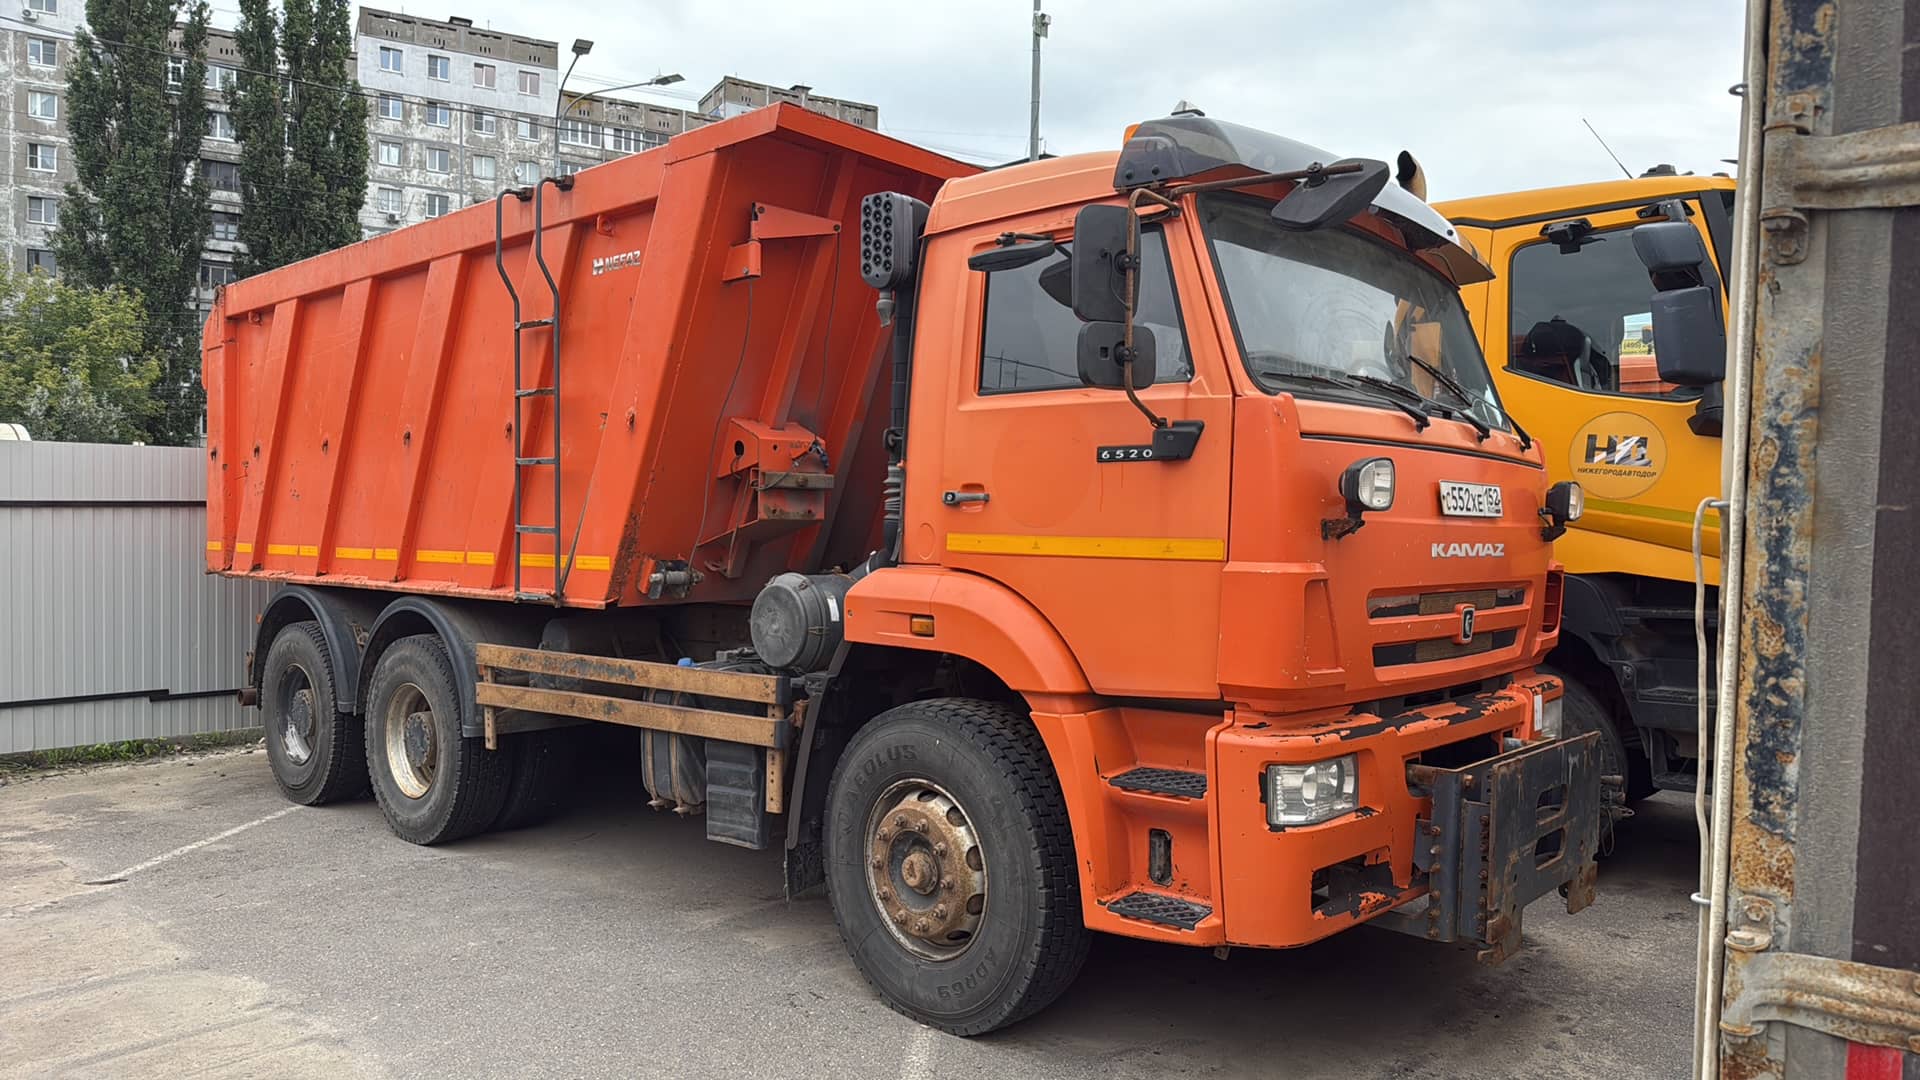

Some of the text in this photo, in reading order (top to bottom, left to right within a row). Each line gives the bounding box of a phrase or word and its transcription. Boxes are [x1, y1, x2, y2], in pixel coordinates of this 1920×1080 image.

[605, 250, 641, 271] NEFAZ
[1101, 449, 1153, 459] 6520
[1578, 467, 1657, 477] НИЖЕГОРОДАВТОДОР
[1484, 488, 1501, 506] 152
[1431, 543, 1505, 558] KAMAZ
